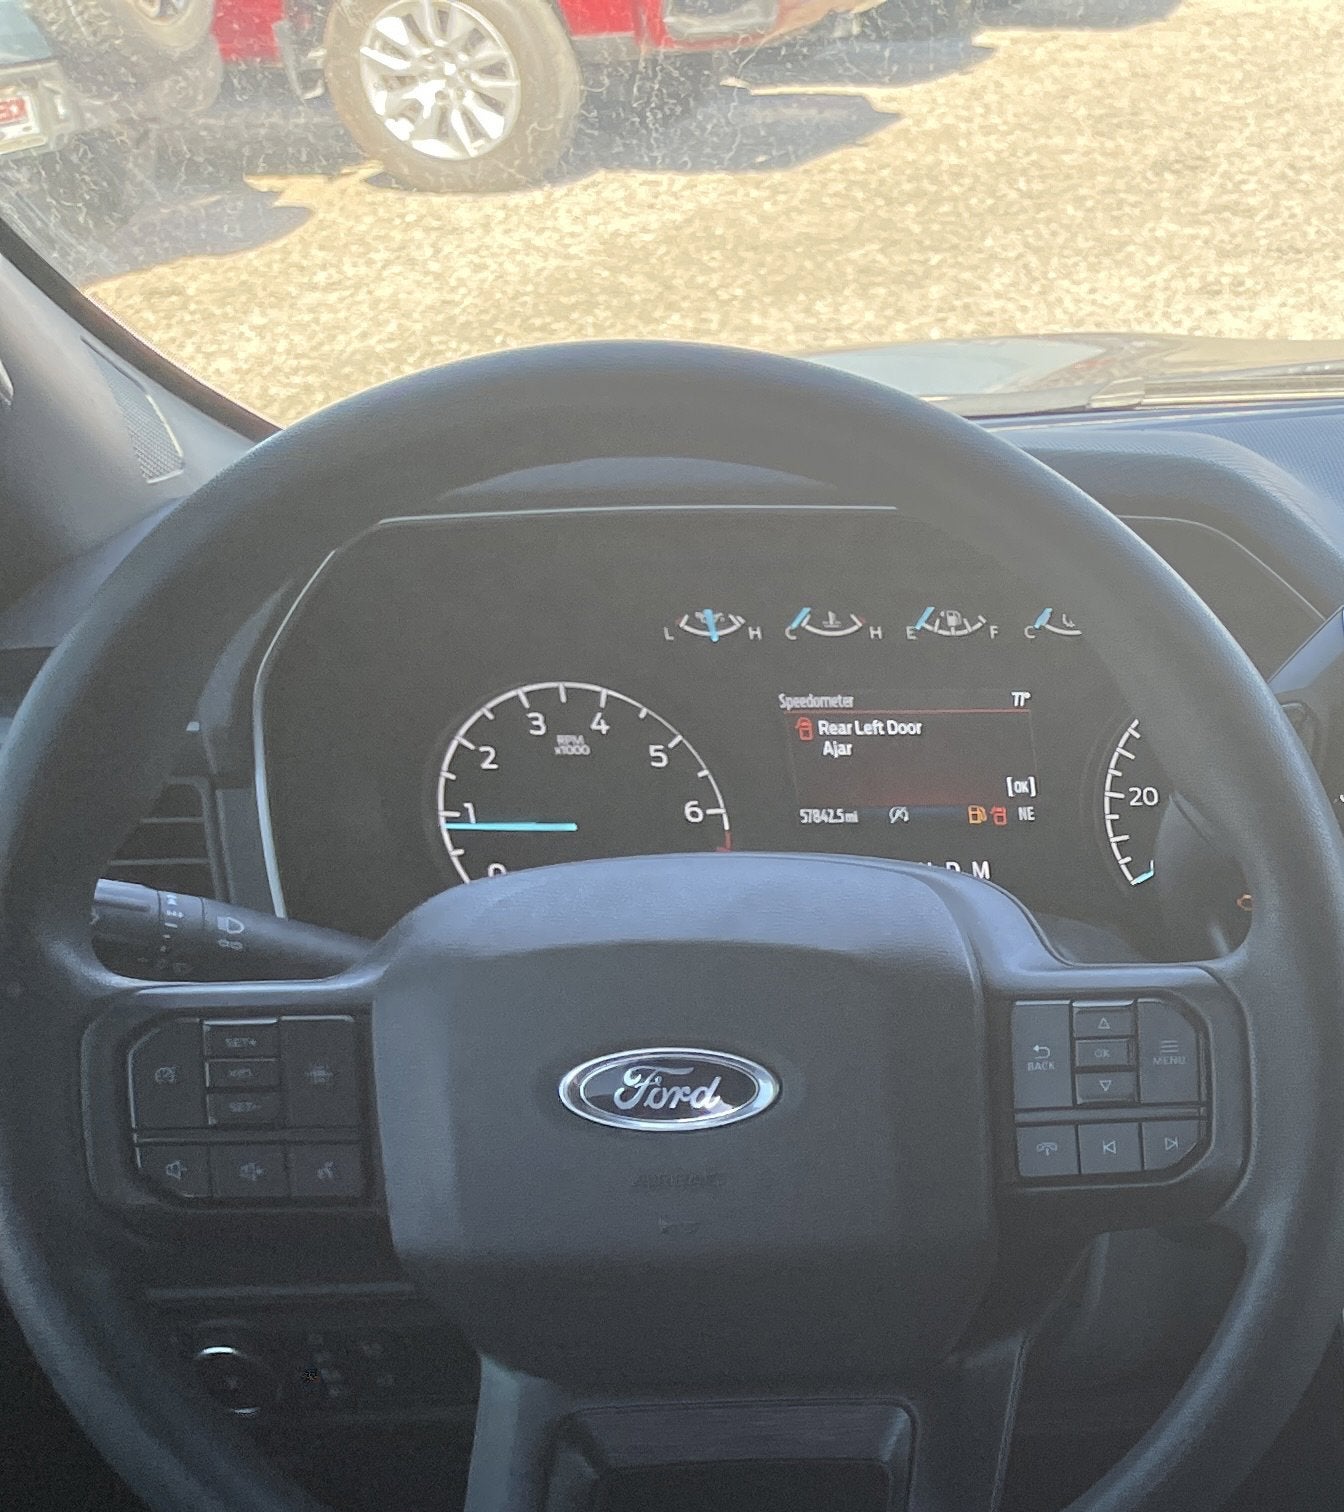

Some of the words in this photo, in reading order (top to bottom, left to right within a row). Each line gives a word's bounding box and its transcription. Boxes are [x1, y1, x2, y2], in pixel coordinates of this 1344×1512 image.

[664, 627, 675, 641] L
[749, 627, 762, 641] H
[785, 626, 798, 641] C
[870, 626, 883, 640] H
[906, 627, 917, 640] E
[990, 626, 999, 640] F
[1024, 626, 1036, 640] C
[778, 694, 854, 710] Speedometer
[526, 712, 547, 735] 3
[590, 712, 610, 735] 4
[817, 720, 852, 736] Rear
[854, 720, 884, 736] Left
[887, 720, 922, 736] Door
[649, 745, 669, 768] 5
[823, 741, 852, 758] Ajar
[478, 746, 499, 770] 2
[1128, 787, 1159, 806] 20
[463, 803, 477, 823] 1
[684, 800, 704, 824] 6
[1018, 807, 1035, 821] NE
[971, 861, 990, 879] M
[1027, 1061, 1056, 1072] BACK
[1153, 1056, 1187, 1066] MENU
[613, 1065, 722, 1110] Ford
